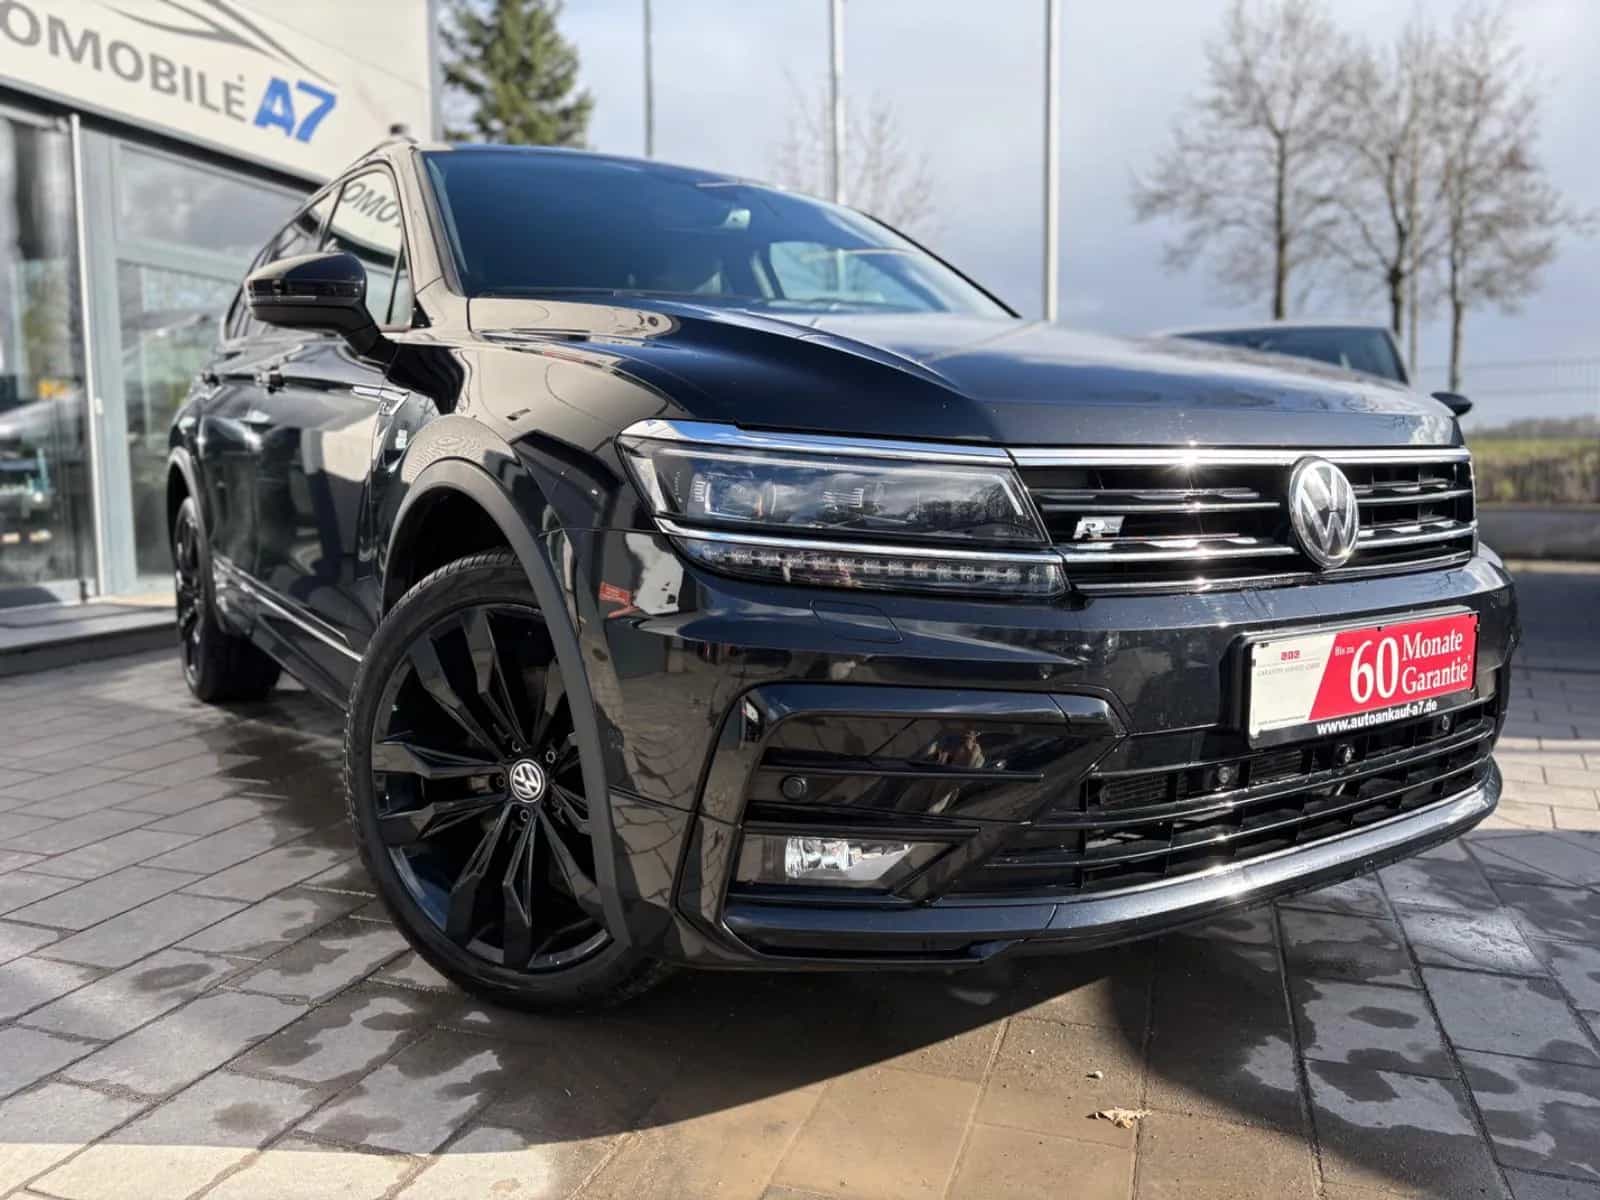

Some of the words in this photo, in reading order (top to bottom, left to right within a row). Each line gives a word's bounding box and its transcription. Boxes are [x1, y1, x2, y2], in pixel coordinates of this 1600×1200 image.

[253, 76, 337, 144] A7
[1350, 637, 1399, 704] 60
[1402, 628, 1463, 661] Monate
[1316, 698, 1438, 735] www.autoankauf-a7.de
